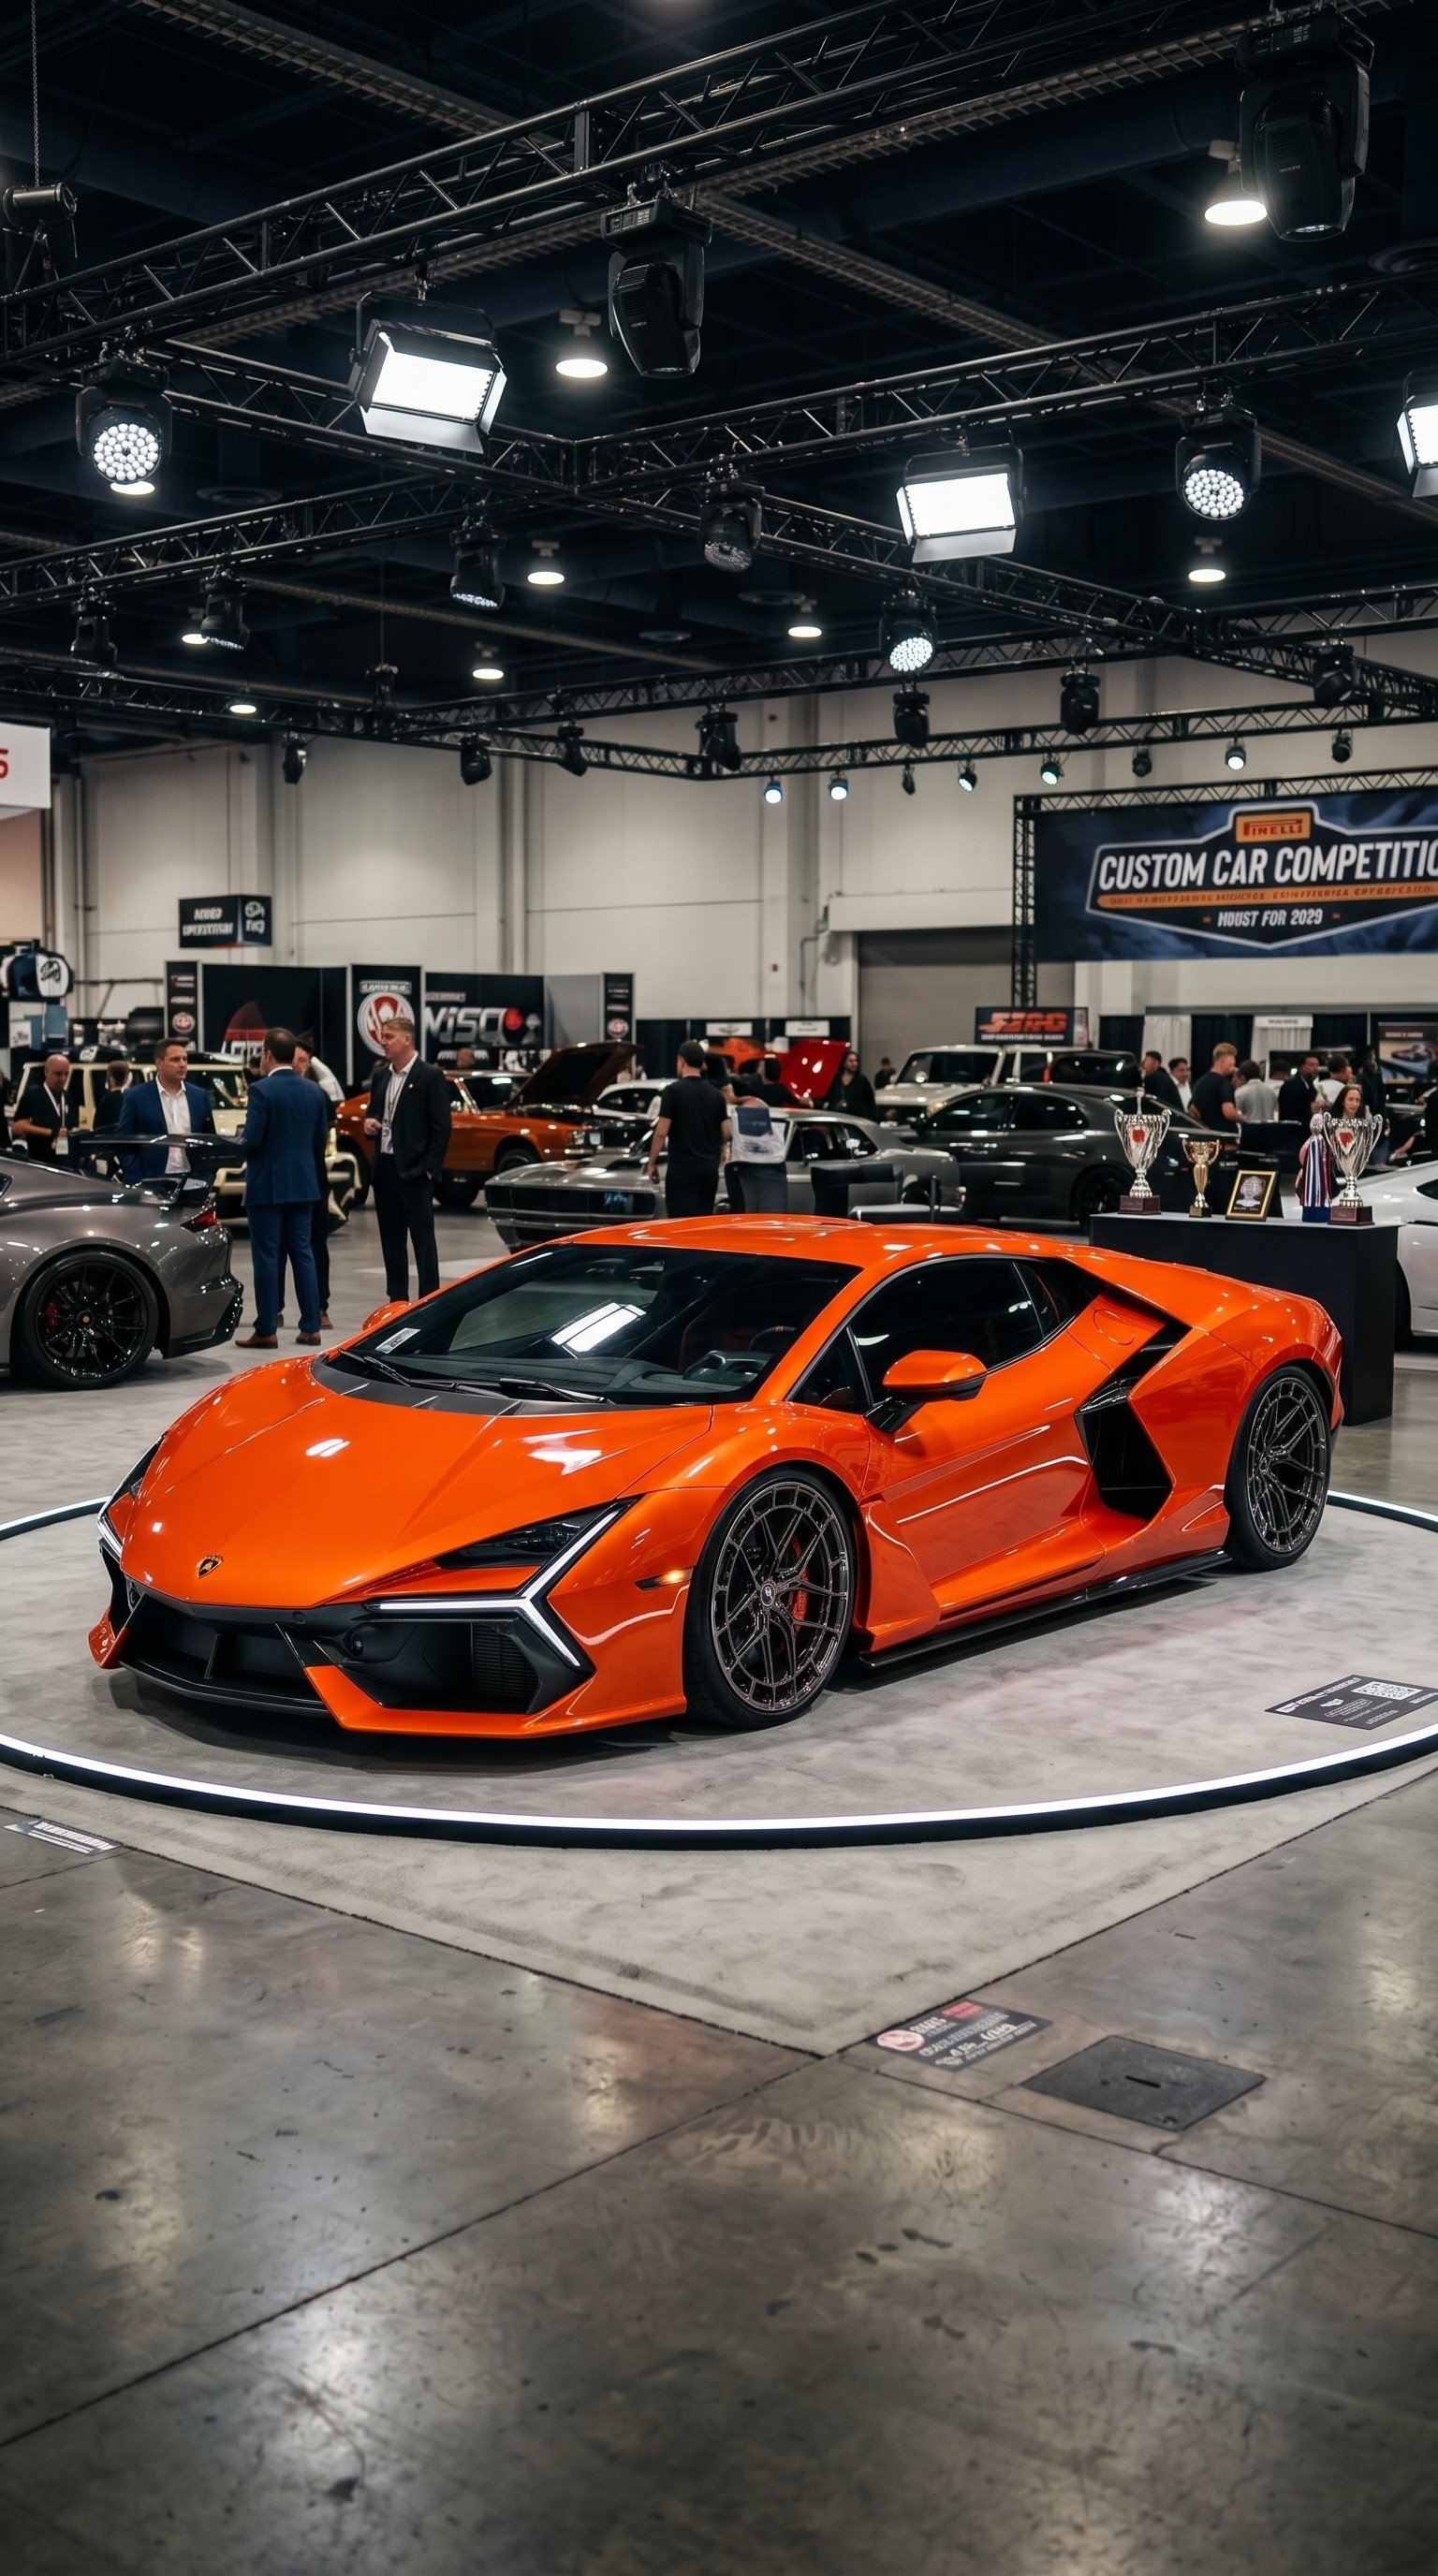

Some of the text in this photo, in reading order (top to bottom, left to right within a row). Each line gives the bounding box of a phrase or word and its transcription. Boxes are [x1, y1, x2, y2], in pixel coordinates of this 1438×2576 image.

[1243, 818, 1303, 837] PIRELLI
[1099, 852, 1208, 890] CUSTOM
[1211, 848, 1269, 886] CAR
[1261, 908, 1287, 927] FOR
[1290, 907, 1324, 926] 2029
